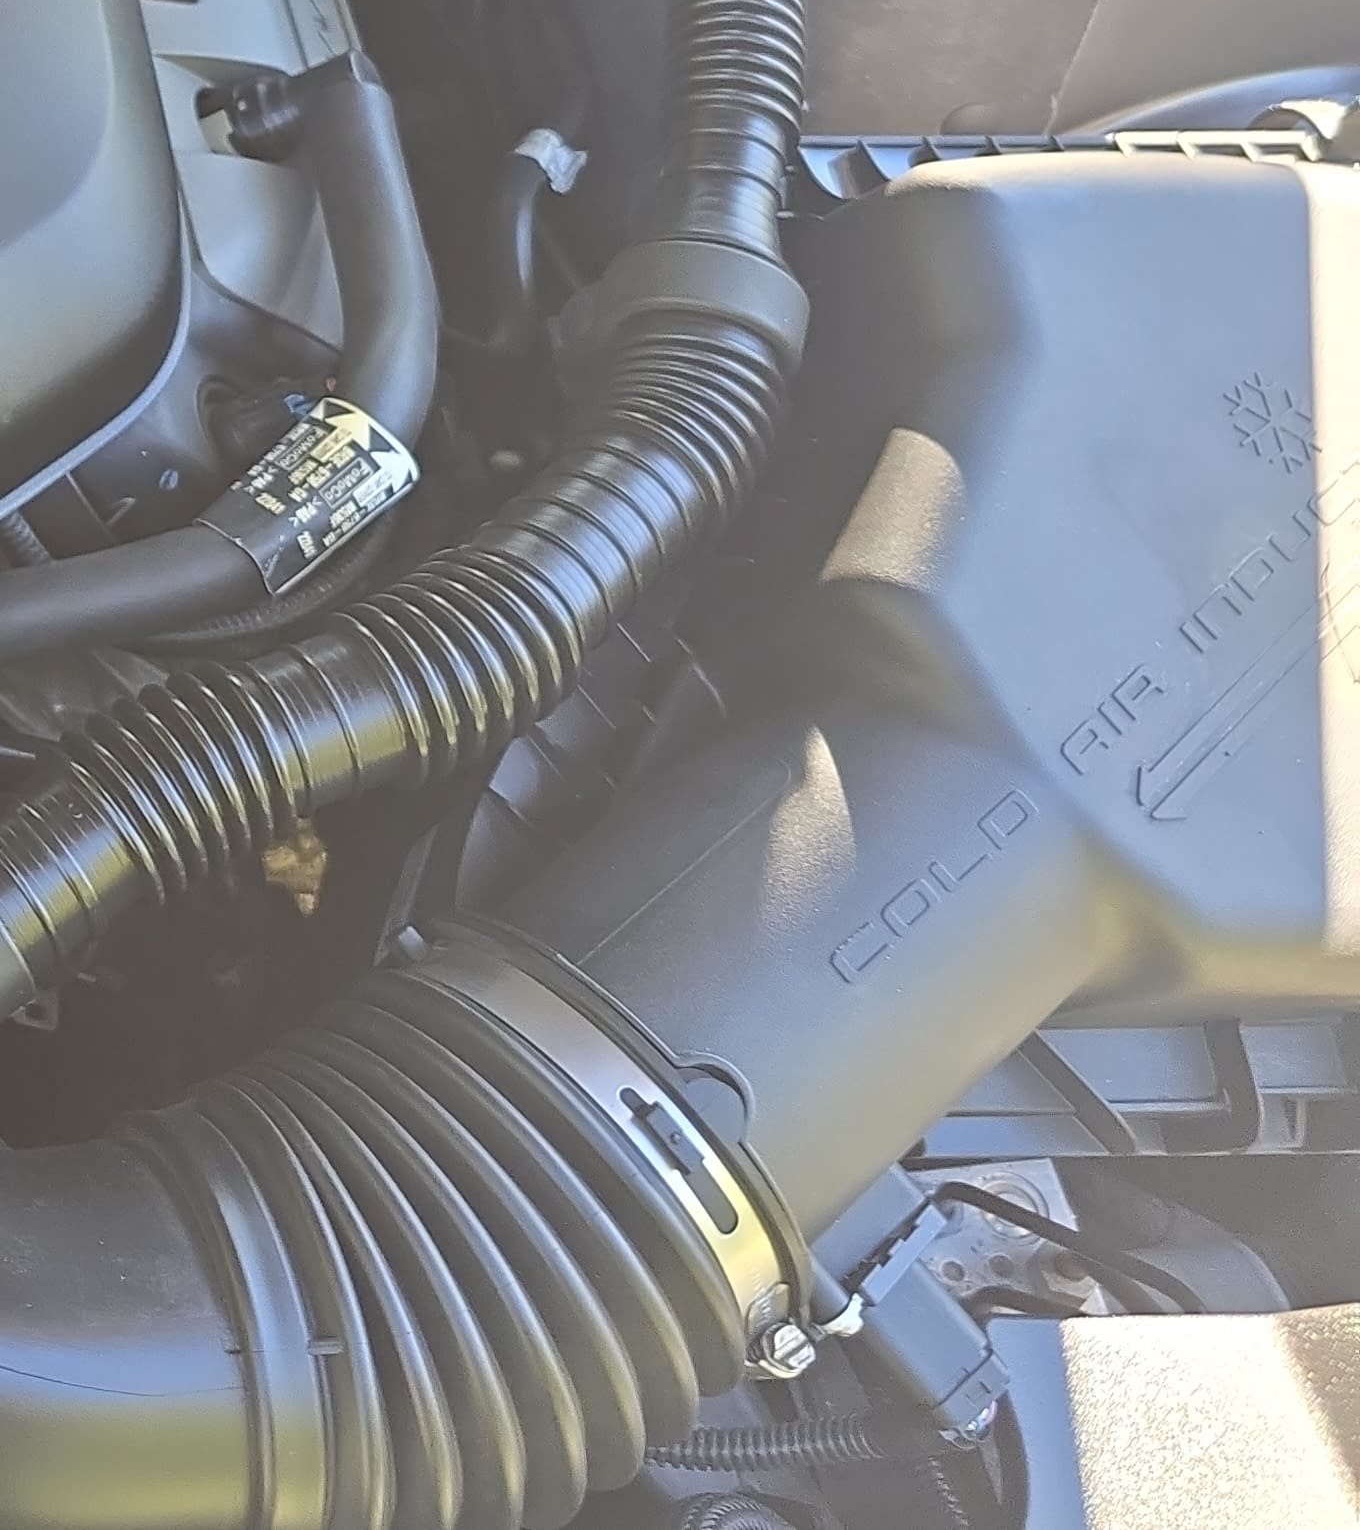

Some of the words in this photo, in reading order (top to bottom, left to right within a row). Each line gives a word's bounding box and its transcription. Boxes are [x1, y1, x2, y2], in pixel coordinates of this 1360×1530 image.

[280, 427, 323, 468] FoMoCo
[324, 460, 369, 501] FoMoCo
[830, 787, 1041, 984] COLD
[1061, 664, 1165, 776] AIR
[1178, 460, 1360, 656] INDUC
